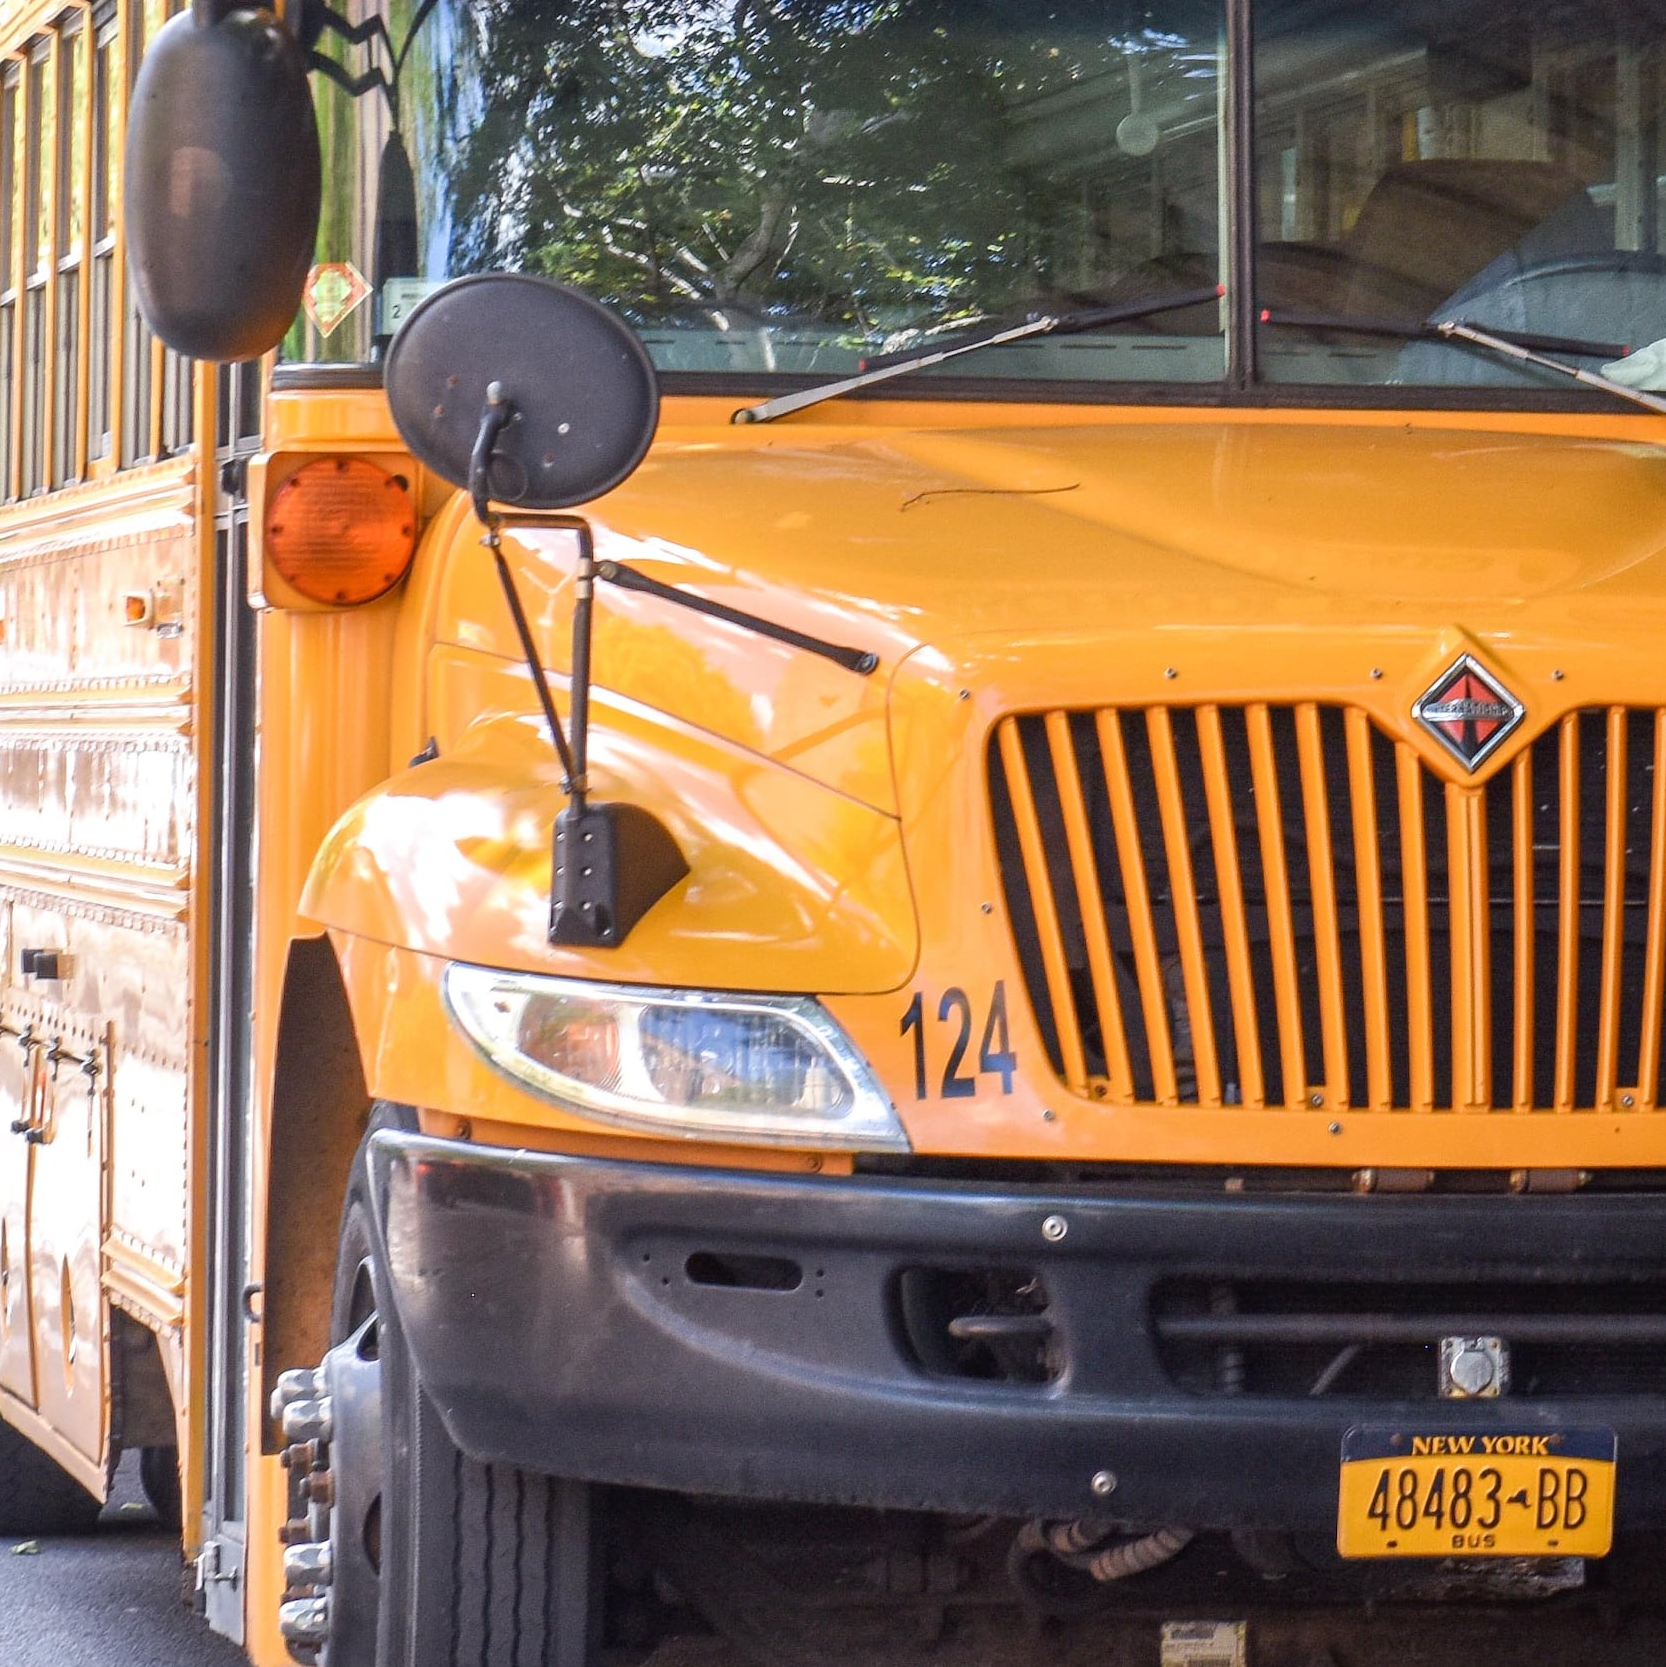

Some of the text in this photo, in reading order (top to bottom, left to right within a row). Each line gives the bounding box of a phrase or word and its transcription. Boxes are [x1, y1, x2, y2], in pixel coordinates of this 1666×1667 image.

[899, 979, 1018, 1101] 124
[1411, 1435, 1550, 1456] NEW YORK
[1451, 1534, 1496, 1549] BUS
